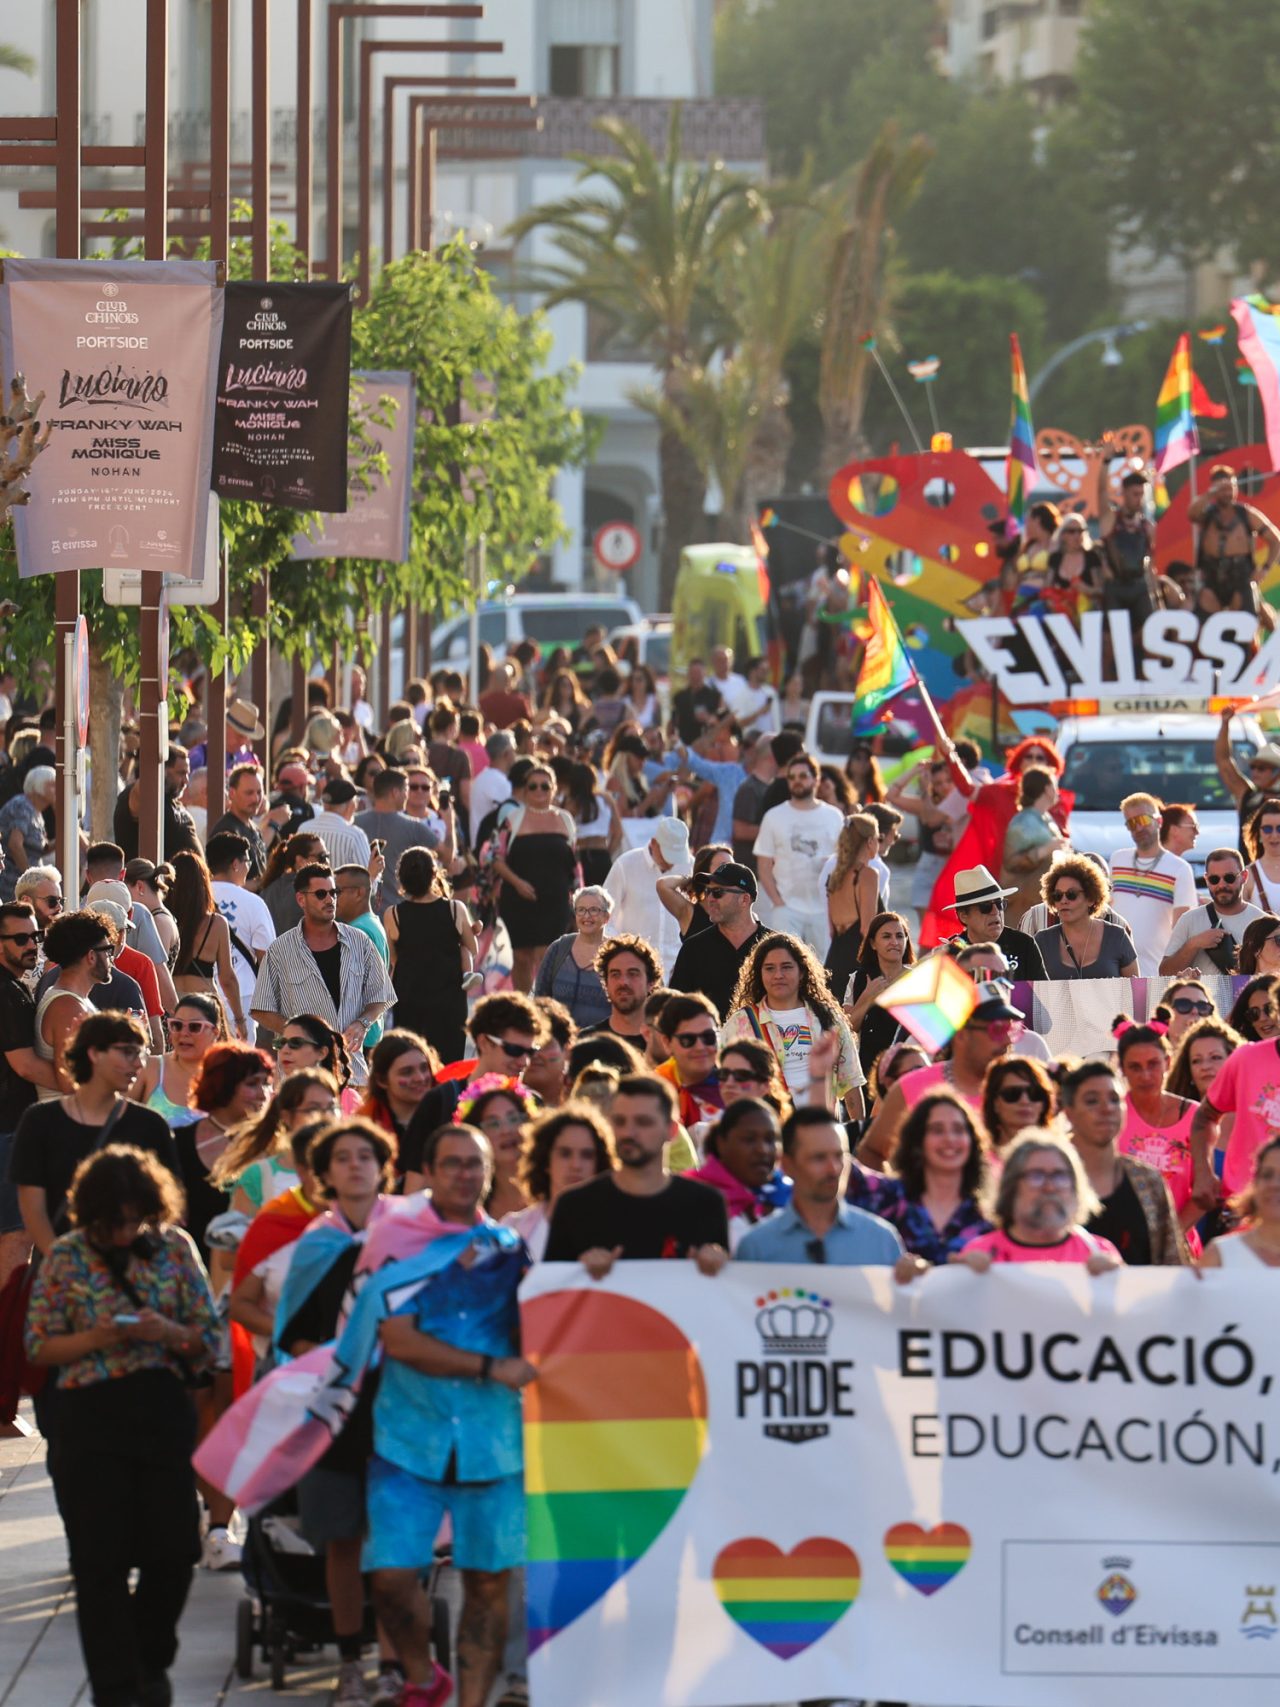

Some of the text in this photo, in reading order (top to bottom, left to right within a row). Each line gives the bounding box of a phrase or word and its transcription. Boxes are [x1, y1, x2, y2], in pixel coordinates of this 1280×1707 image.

[96, 301, 127, 312] CLUB
[85, 313, 139, 324] CHINOIS
[255, 312, 279, 322] CLUB
[246, 321, 287, 331] CHINOIS
[77, 336, 148, 349] PORTSIDE
[240, 338, 294, 349] PORTSIDE
[59, 365, 168, 409] Luciano
[284, 400, 319, 409] WAH
[46, 419, 182, 432] FRANKY WAH
[248, 433, 285, 441] NOHAN
[92, 438, 141, 448] MISS
[71, 449, 161, 460] MONIQUE
[91, 467, 141, 477] NOHAN
[62, 540, 98, 550] eivissa
[1114, 699, 1188, 712] GRUA
[897, 1324, 1273, 1395] EDUCACIÓ,
[737, 1361, 854, 1418] PRIDE
[1014, 1623, 1219, 1646] Consell d'Eivissa
